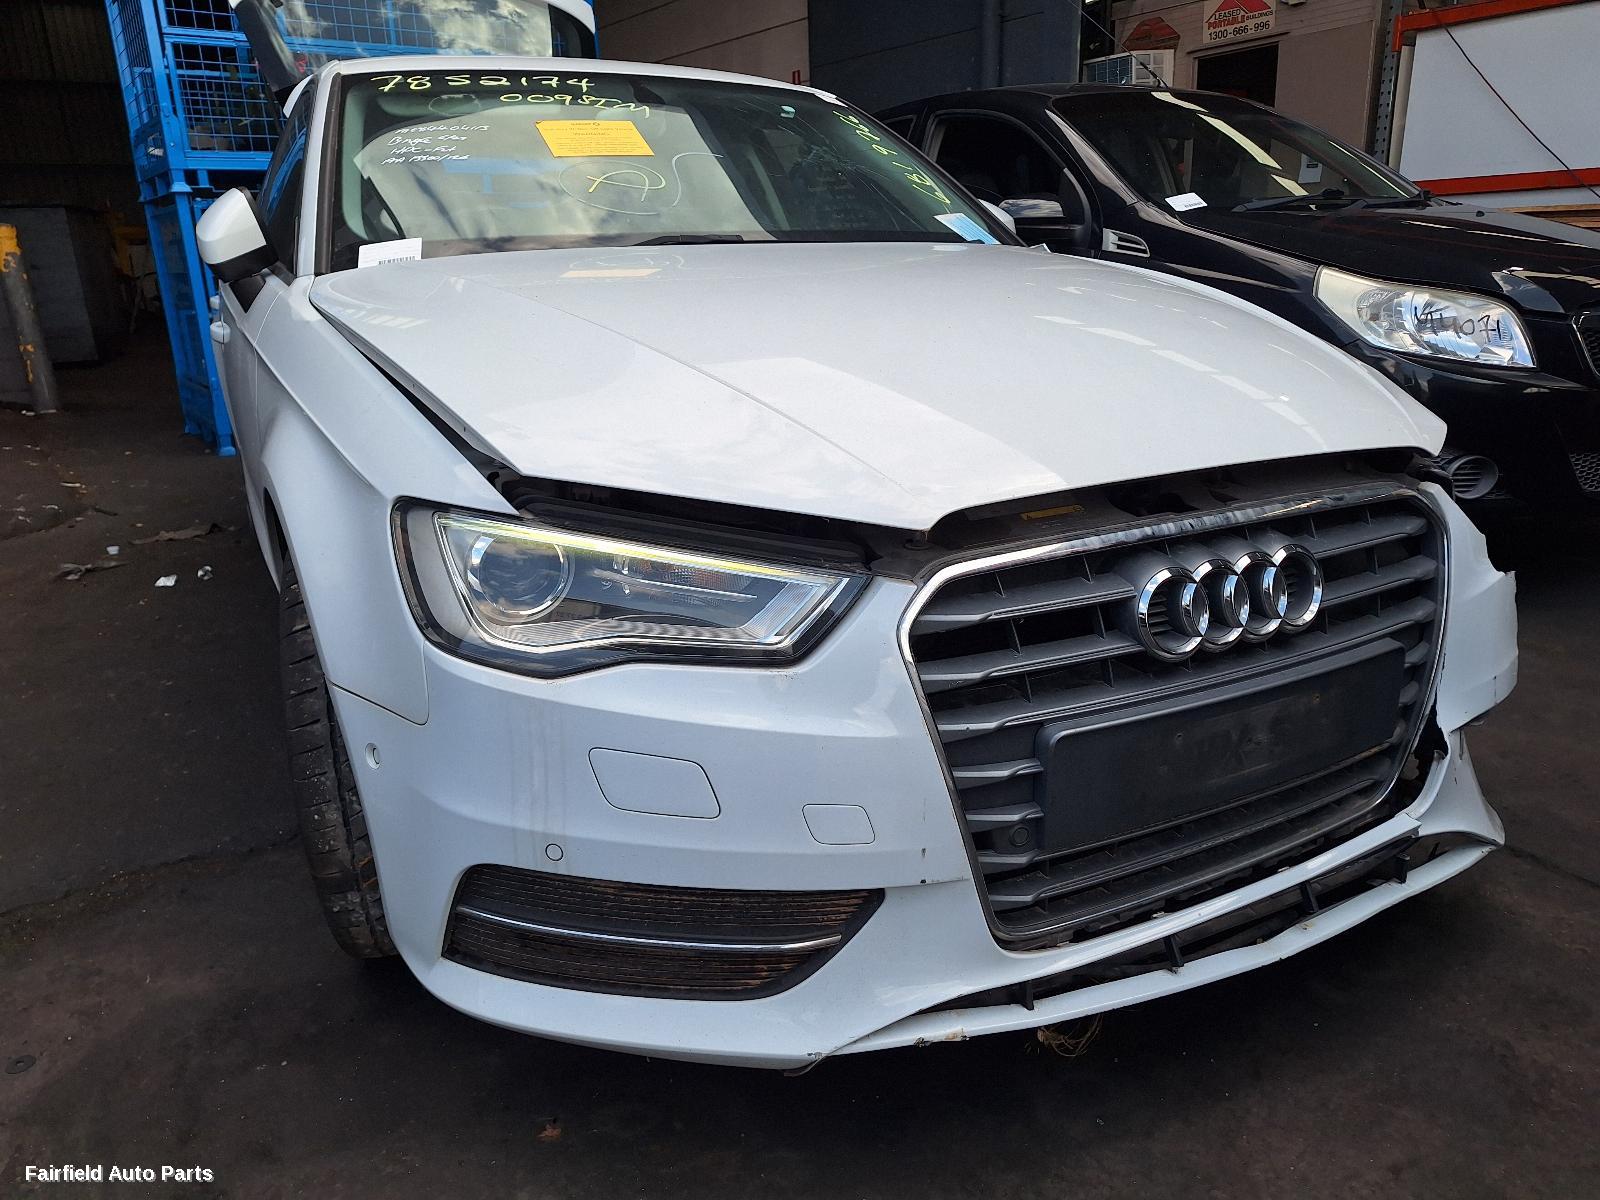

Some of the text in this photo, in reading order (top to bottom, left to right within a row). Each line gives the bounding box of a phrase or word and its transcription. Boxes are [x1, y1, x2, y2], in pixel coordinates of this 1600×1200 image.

[1214, 9, 1241, 20] LEASED
[1246, 10, 1273, 21] BUILDINGS
[1208, 21, 1270, 41] 1300-666-996
